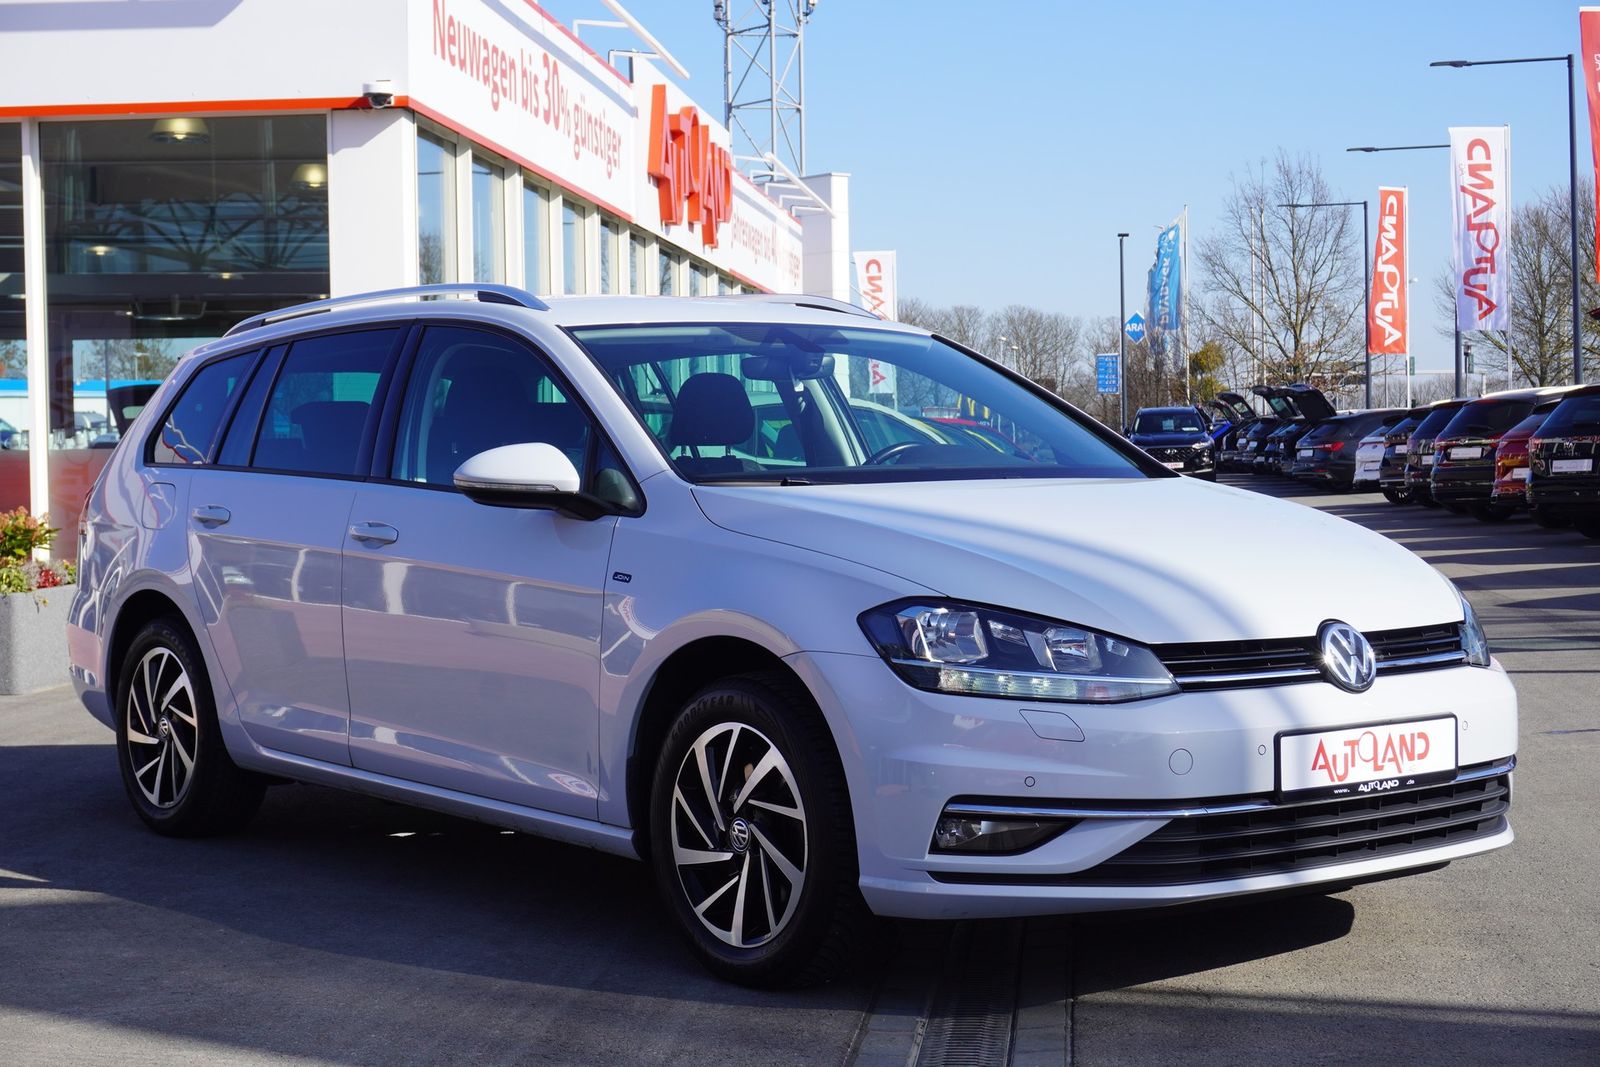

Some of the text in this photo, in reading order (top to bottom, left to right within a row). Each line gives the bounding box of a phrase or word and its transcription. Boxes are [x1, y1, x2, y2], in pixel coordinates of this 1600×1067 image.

[433, 0, 621, 179] Neuwagen bis 30% günstiger
[648, 84, 733, 249] AUTOLAND
[1311, 731, 1430, 782] AUTOLAND
[1358, 779, 1399, 792] AUTOLAND
